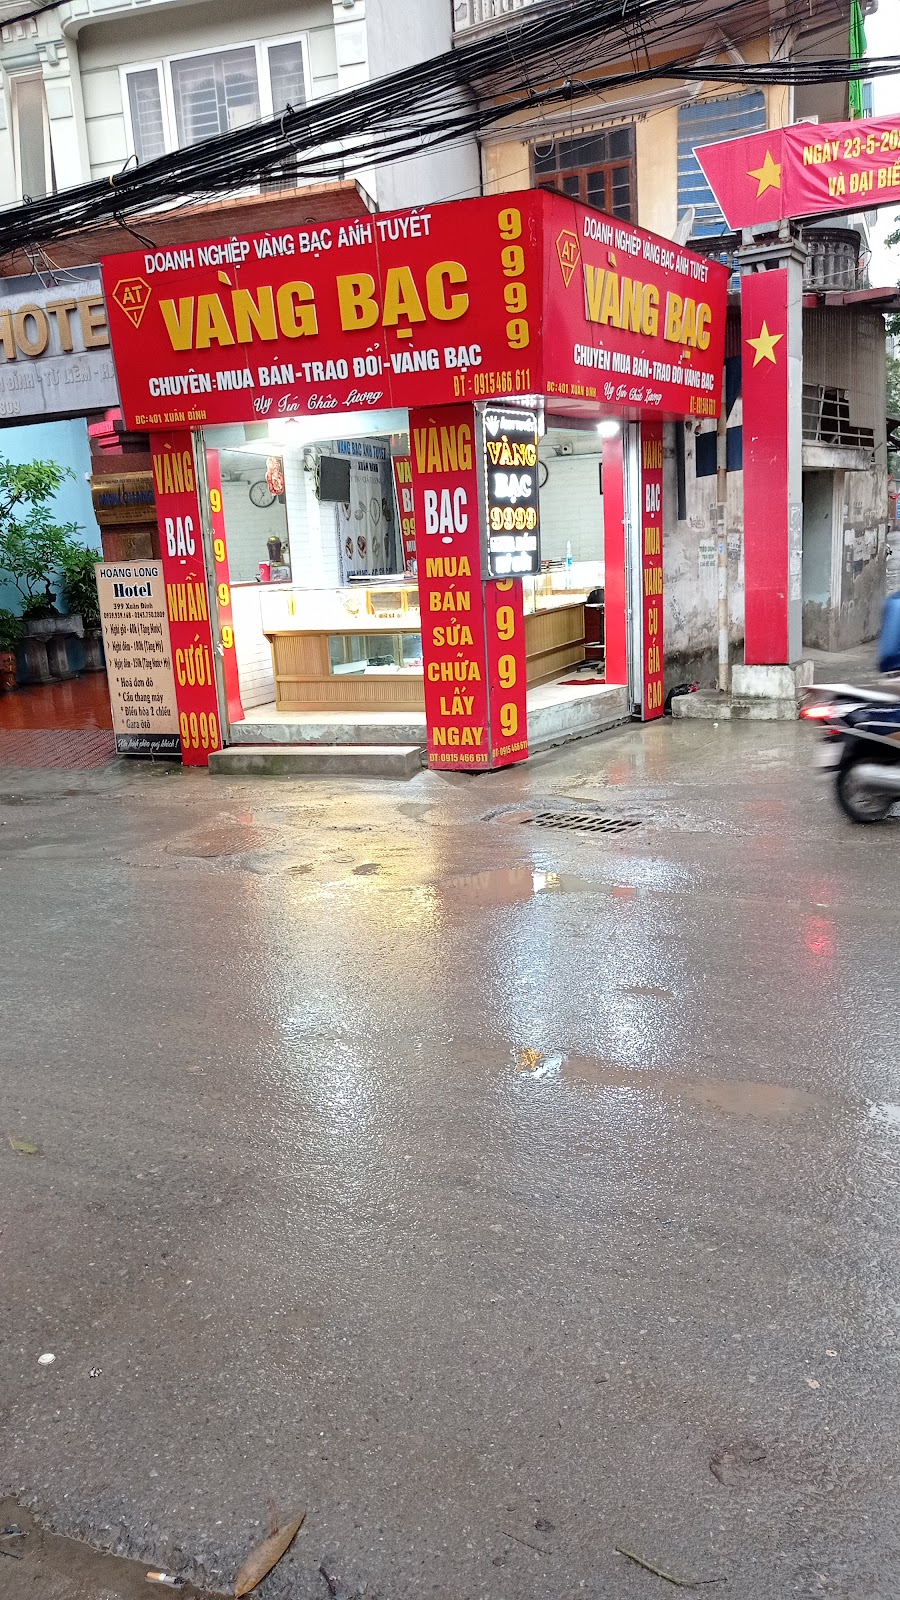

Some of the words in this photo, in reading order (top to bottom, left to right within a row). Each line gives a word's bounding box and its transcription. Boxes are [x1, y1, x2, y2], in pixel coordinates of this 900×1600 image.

[803, 139, 840, 166] NGÀY
[828, 171, 846, 197] VÀ
[849, 169, 873, 196] ĐẠI
[144, 248, 195, 274] DOANH
[197, 236, 250, 269] NGHIỆP
[252, 232, 295, 259] VÀNG
[298, 228, 333, 258] BẠC
[375, 207, 432, 242] TUYẾT
[560, 240, 577, 260] AT
[584, 216, 614, 247] DOANH
[614, 230, 642, 259] NGHIỆP
[642, 236, 660, 264] VÀNG
[660, 248, 675, 275] BẠC
[690, 258, 709, 283] TUYẾT
[122, 285, 143, 306] AT
[159, 269, 319, 352] VÀNG
[335, 260, 470, 339] BẠC
[583, 251, 660, 337] VÀNG
[664, 291, 712, 359] BẠC
[444, 344, 482, 373] BẠC
[573, 340, 611, 371] CHUYÊN
[612, 353, 631, 375] MUA
[671, 354, 684, 384] ĐỔI
[684, 363, 701, 387] VÀNG
[701, 373, 715, 394] BẠC
[515, 368, 531, 391] 611
[413, 417, 473, 474] VÀNG
[487, 434, 537, 467] VÀNG
[643, 432, 663, 470] VÀNG
[152, 442, 195, 495] VÀNG
[396, 457, 413, 484] VÀ
[494, 472, 533, 504] BẠC
[645, 483, 661, 519] BẠC
[424, 486, 468, 544] BẠC
[489, 506, 537, 531] 9999
[164, 515, 196, 565] BẠC
[644, 527, 661, 556] MUA
[100, 566, 132, 578] HOÀNG
[134, 567, 158, 577] LONG
[425, 555, 472, 578] MUA
[644, 560, 663, 596] VÀNG
[113, 582, 152, 598] Hotel
[166, 572, 208, 622] NHẪN
[429, 583, 471, 612] BÁN
[432, 616, 474, 647] SỬA
[174, 633, 213, 687] CƯỚI
[427, 652, 481, 682] CHỮA
[134, 692, 151, 704] thang
[151, 692, 164, 704] máy
[439, 686, 475, 716] LẤY
[647, 680, 662, 710] CAO
[150, 706, 155, 716] 2
[179, 711, 219, 749] 9999
[432, 726, 484, 747] NGAY
[459, 753, 475, 762] 466
[475, 753, 488, 762] 611
